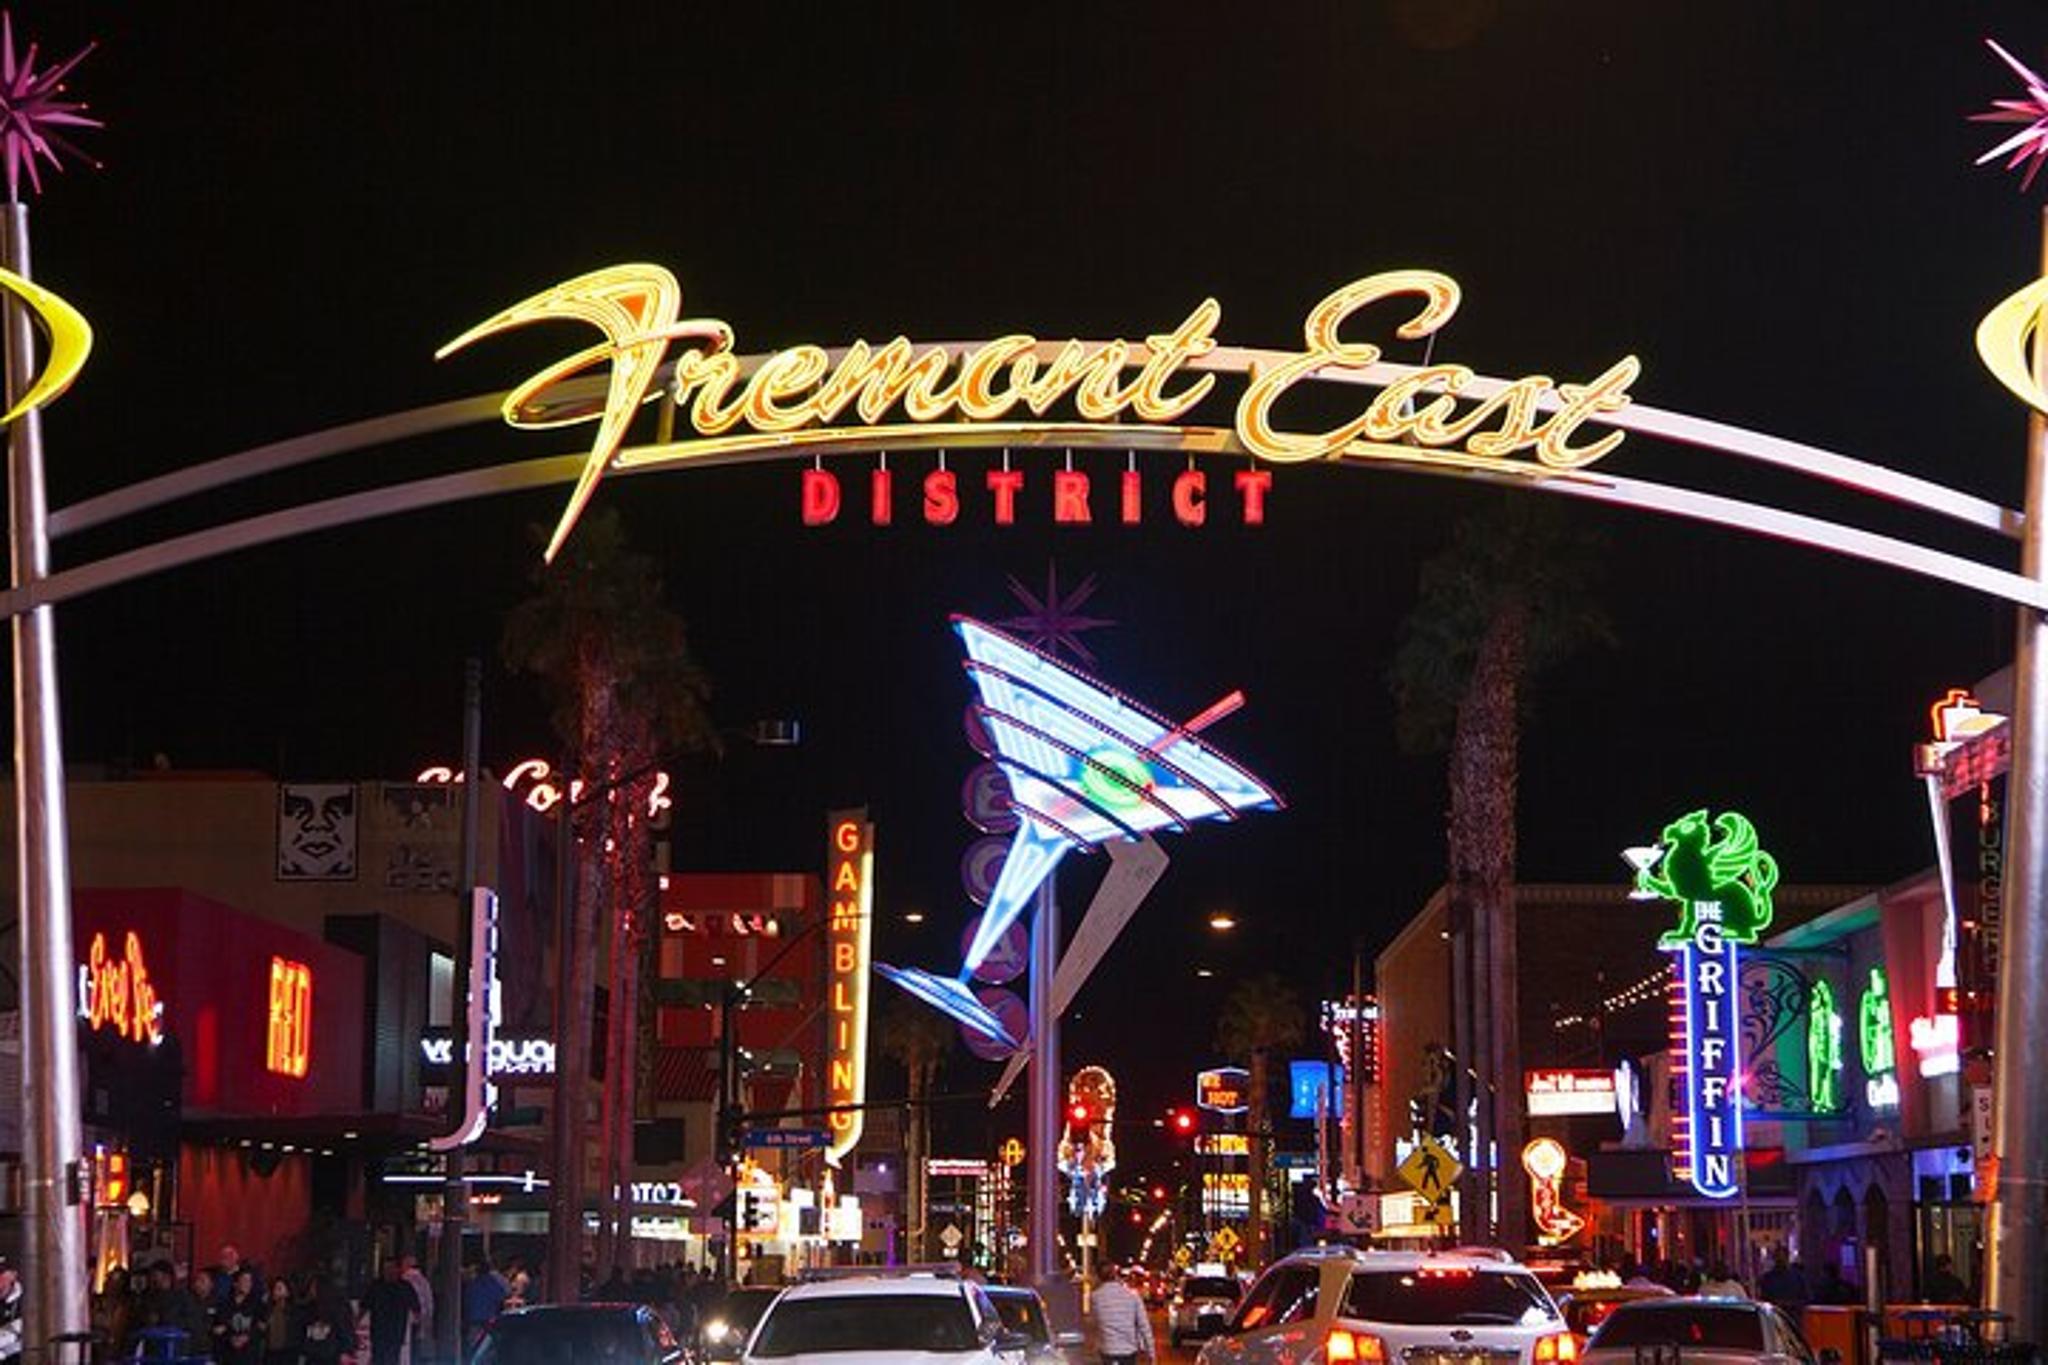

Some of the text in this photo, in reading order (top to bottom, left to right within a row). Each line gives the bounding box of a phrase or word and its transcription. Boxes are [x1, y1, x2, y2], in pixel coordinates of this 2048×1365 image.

[435, 263, 1640, 562] Fremont East
[803, 471, 1272, 525] DISTRICT
[831, 822, 860, 1131] GAMBLING
[1694, 901, 1722, 921] THE
[1697, 923, 1728, 1187] GRIFFIN
